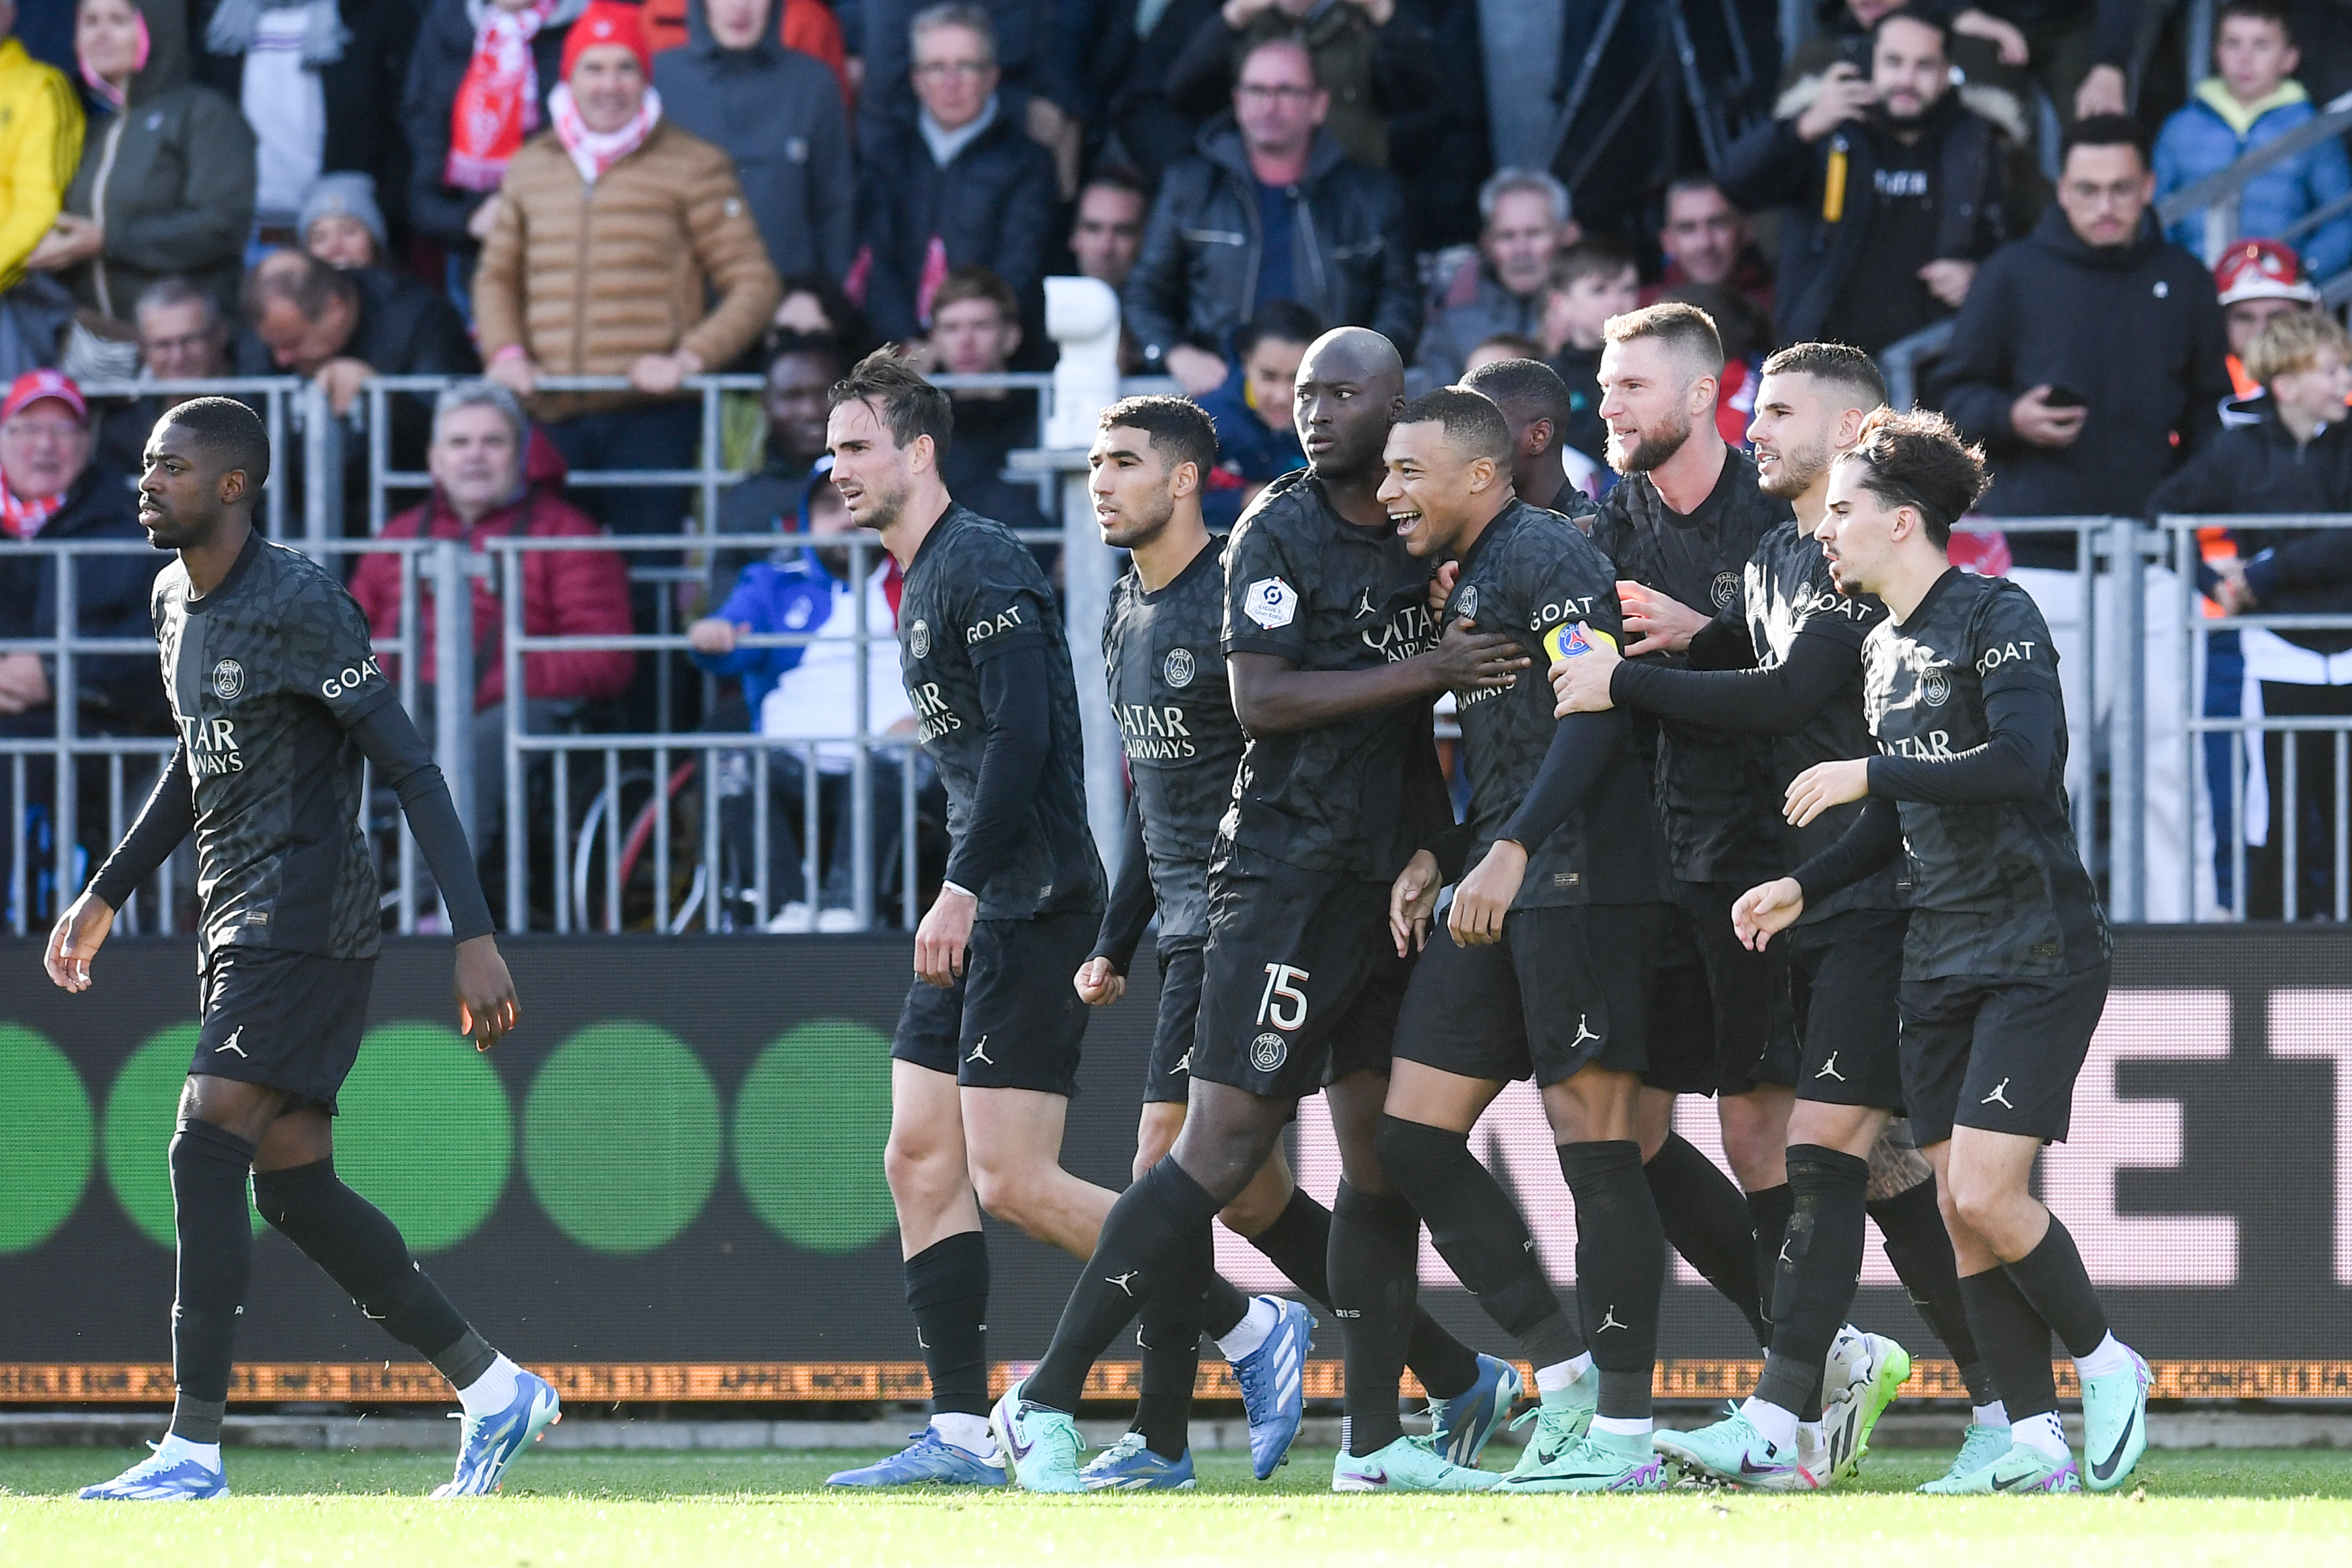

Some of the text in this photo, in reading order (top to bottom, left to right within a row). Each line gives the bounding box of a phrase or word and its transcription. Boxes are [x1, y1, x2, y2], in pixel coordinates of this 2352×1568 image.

[1717, 574, 1738, 583] PARIS
[1818, 593, 1873, 622] OAT
[966, 605, 1023, 644] GOAT
[1560, 624, 1579, 638] PARI
[1171, 650, 1191, 661] PARIS
[219, 661, 240, 672] PARIS
[909, 682, 949, 722] TAR
[175, 715, 239, 752] TAR
[1125, 739, 1196, 759] AIRWAYS
[191, 751, 244, 774] WAYS
[1256, 963, 1310, 1031] 15
[1258, 1035, 1281, 1046] PARIS
[1335, 1309, 1361, 1318] RIS
